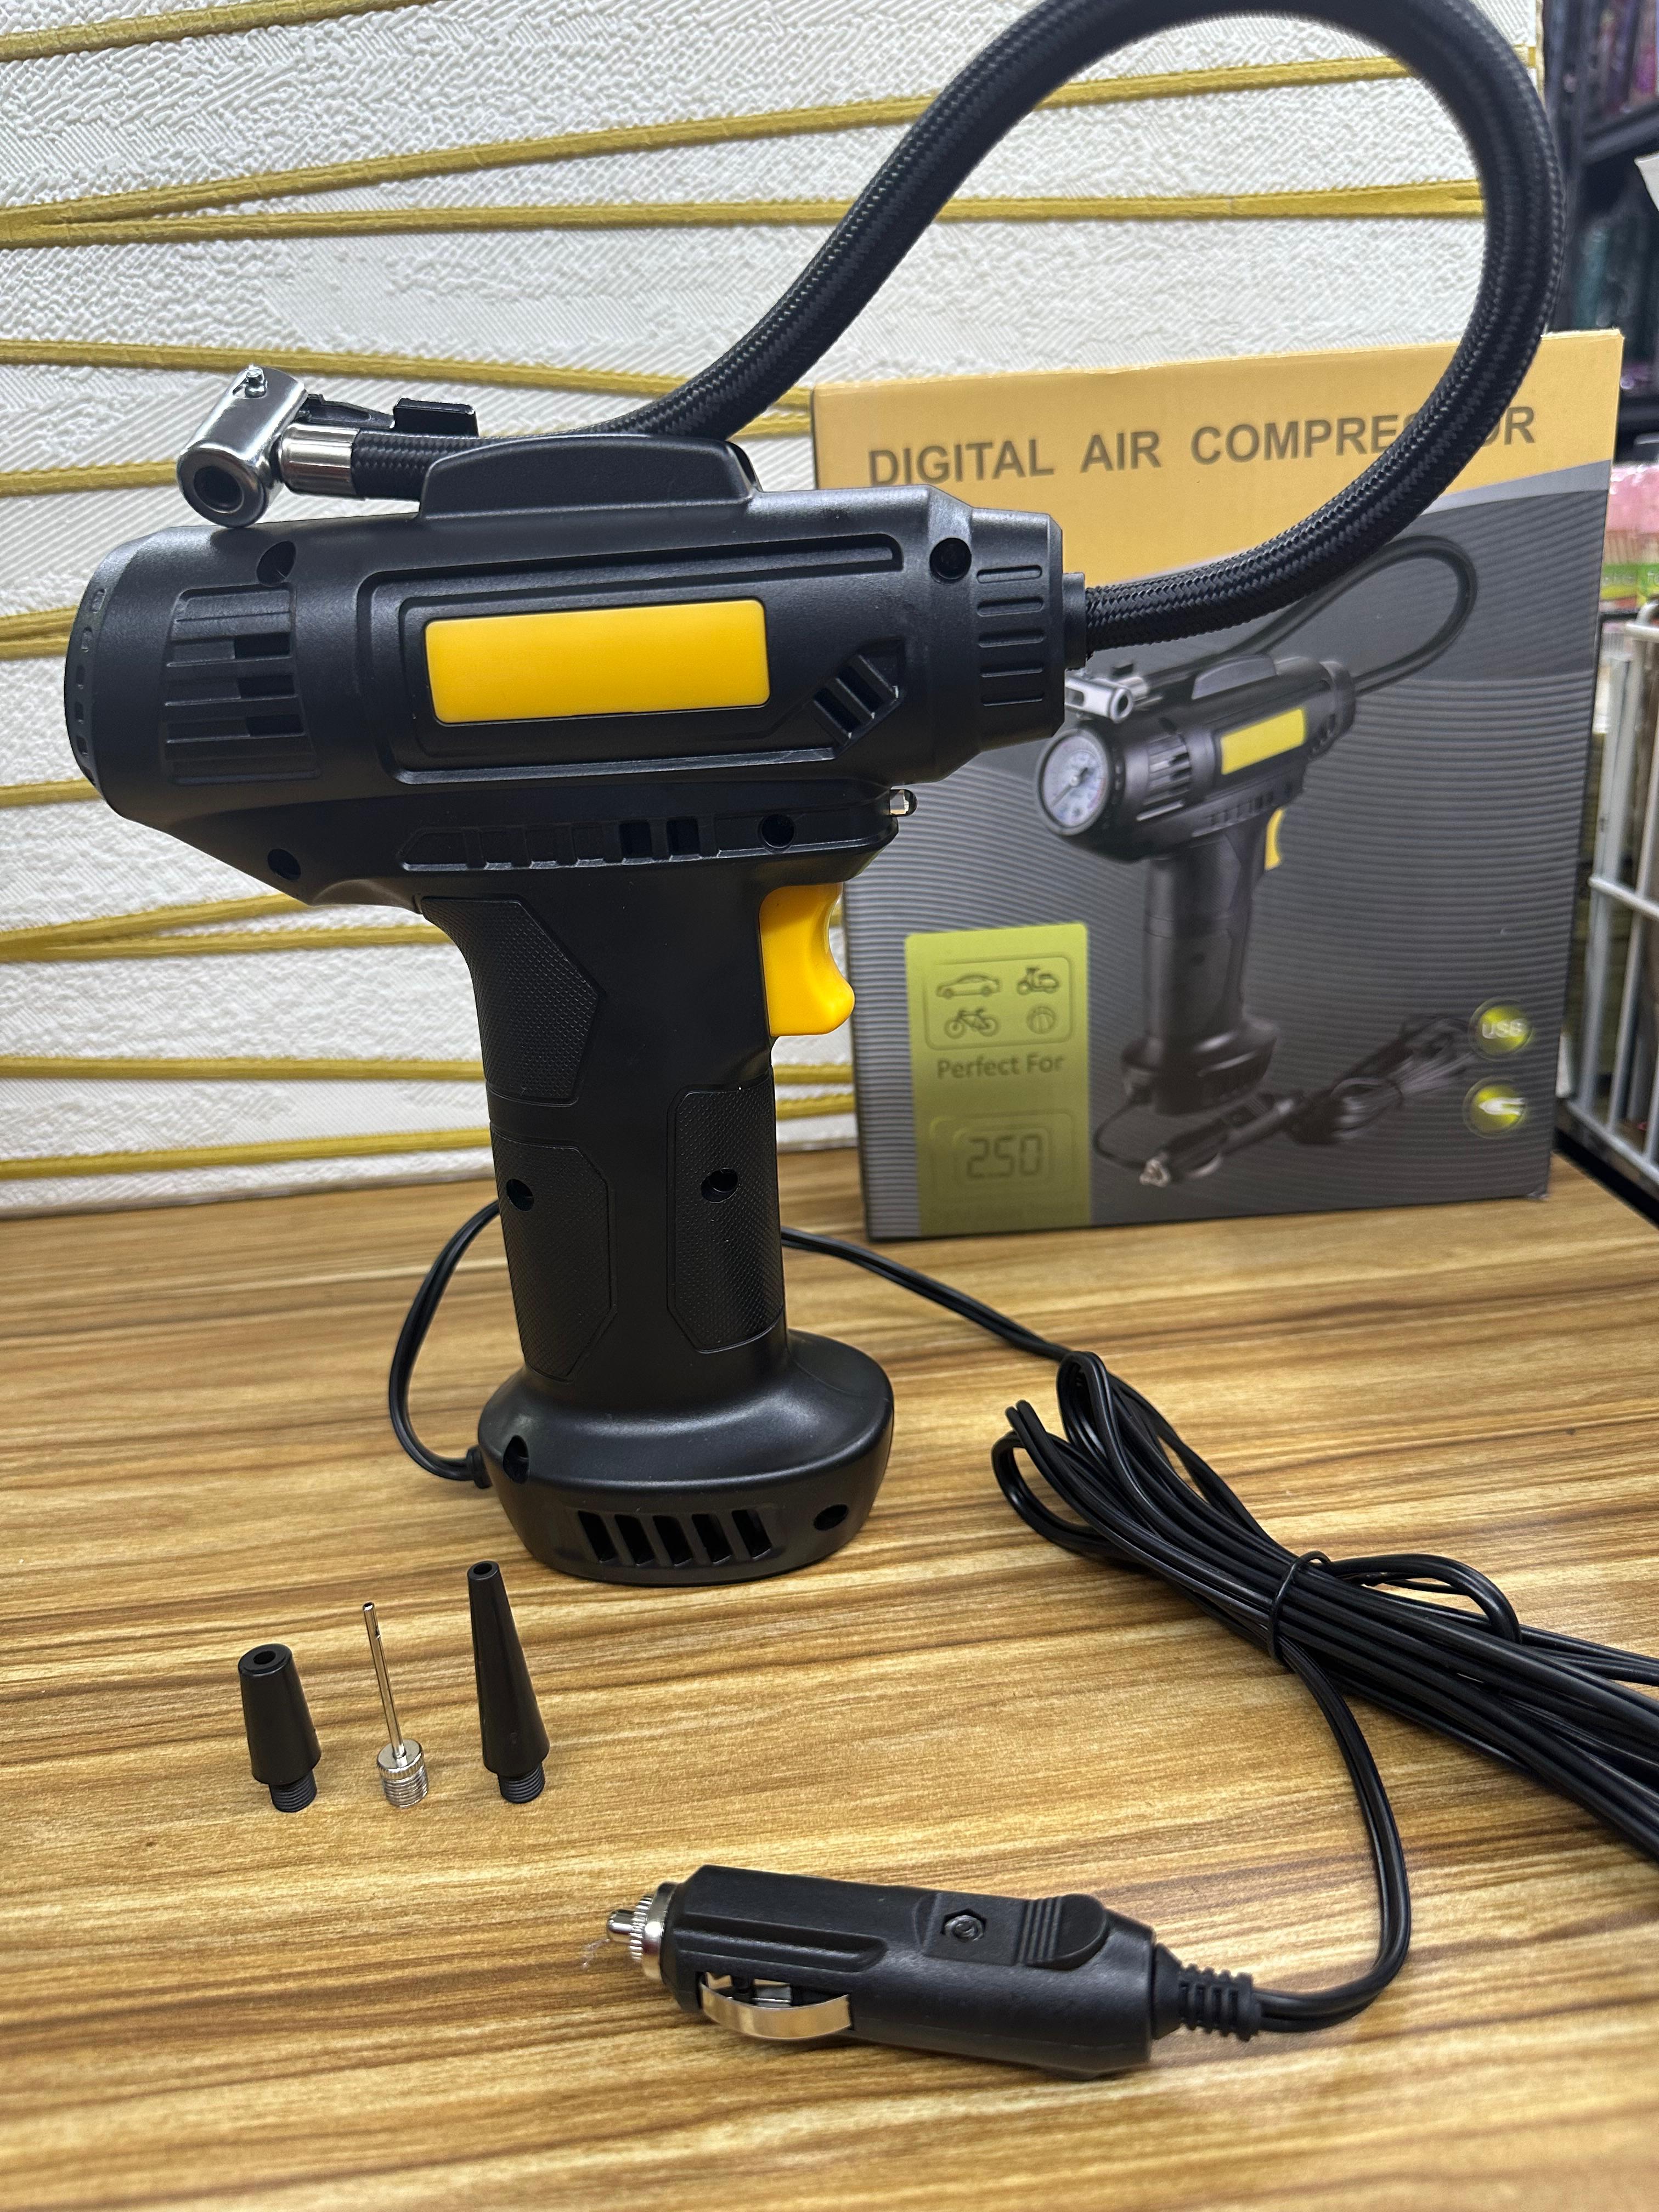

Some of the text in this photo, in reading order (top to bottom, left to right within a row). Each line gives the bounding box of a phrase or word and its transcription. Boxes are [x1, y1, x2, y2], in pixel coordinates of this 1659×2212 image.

[868, 406, 1535, 487] DIGITAL AIR COMPRER
[937, 1051, 1064, 1080] Perfect For
[966, 1133, 1042, 1179] 250
